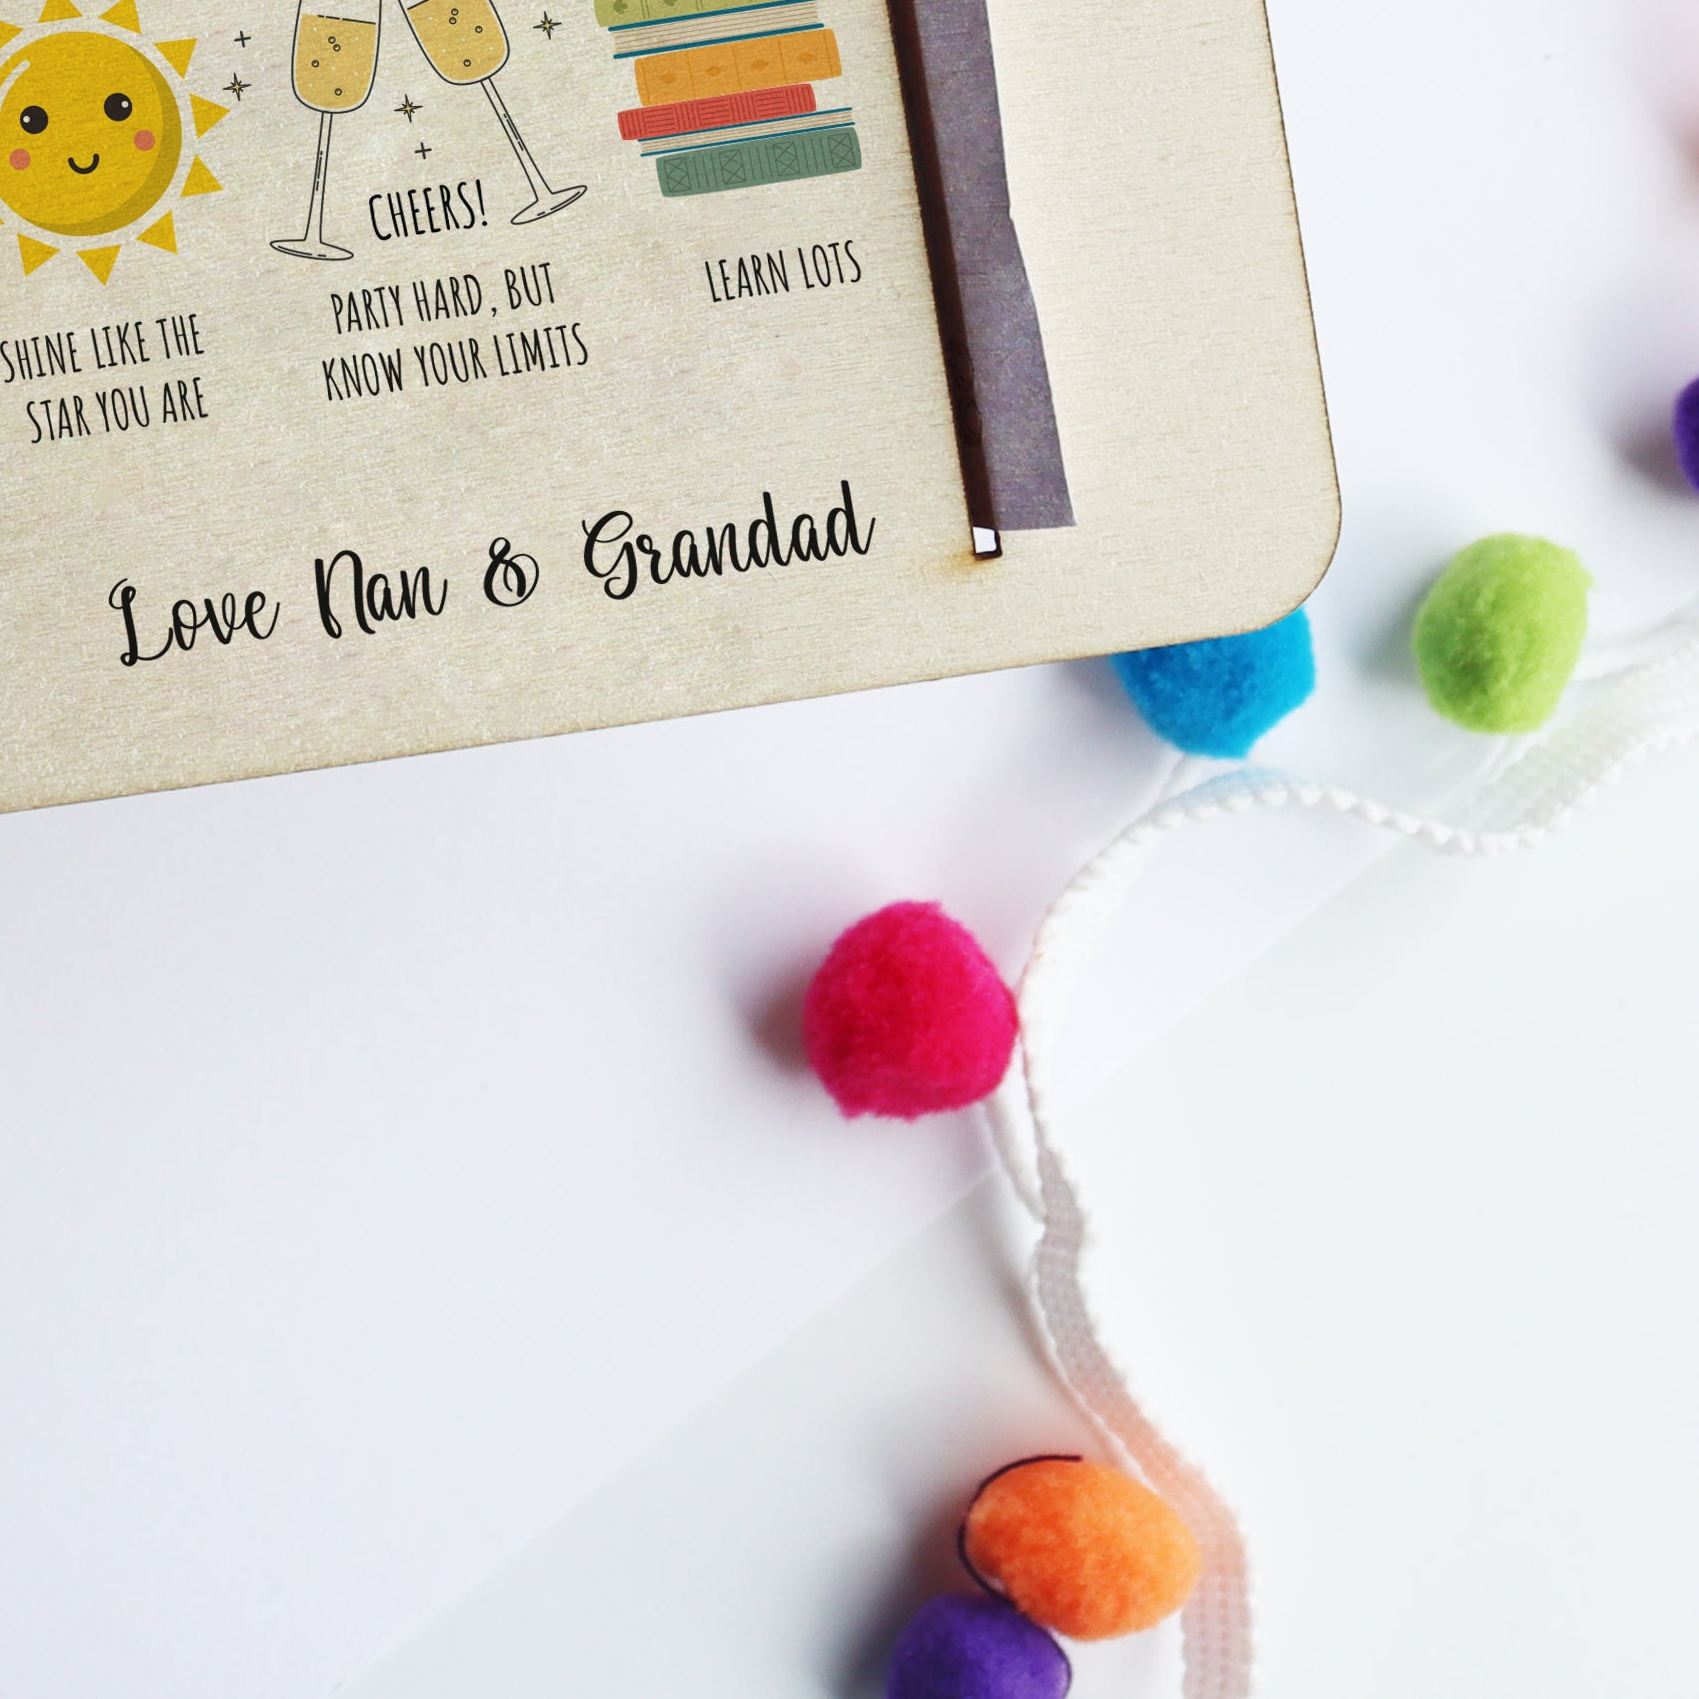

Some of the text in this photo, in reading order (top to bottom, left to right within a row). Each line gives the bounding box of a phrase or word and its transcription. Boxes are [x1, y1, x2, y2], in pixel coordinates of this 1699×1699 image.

[368, 178, 491, 241] CHEERS!
[330, 284, 404, 335] PARTY
[504, 262, 555, 310] BUT
[704, 239, 862, 303] LEARN LOTS
[0, 313, 205, 384] SHINE LIKE THE
[321, 322, 589, 402] KNOW YOUR LIMITS
[26, 376, 209, 444] STAR YOU ARE
[108, 479, 877, 667] Love Nan & Grandad
